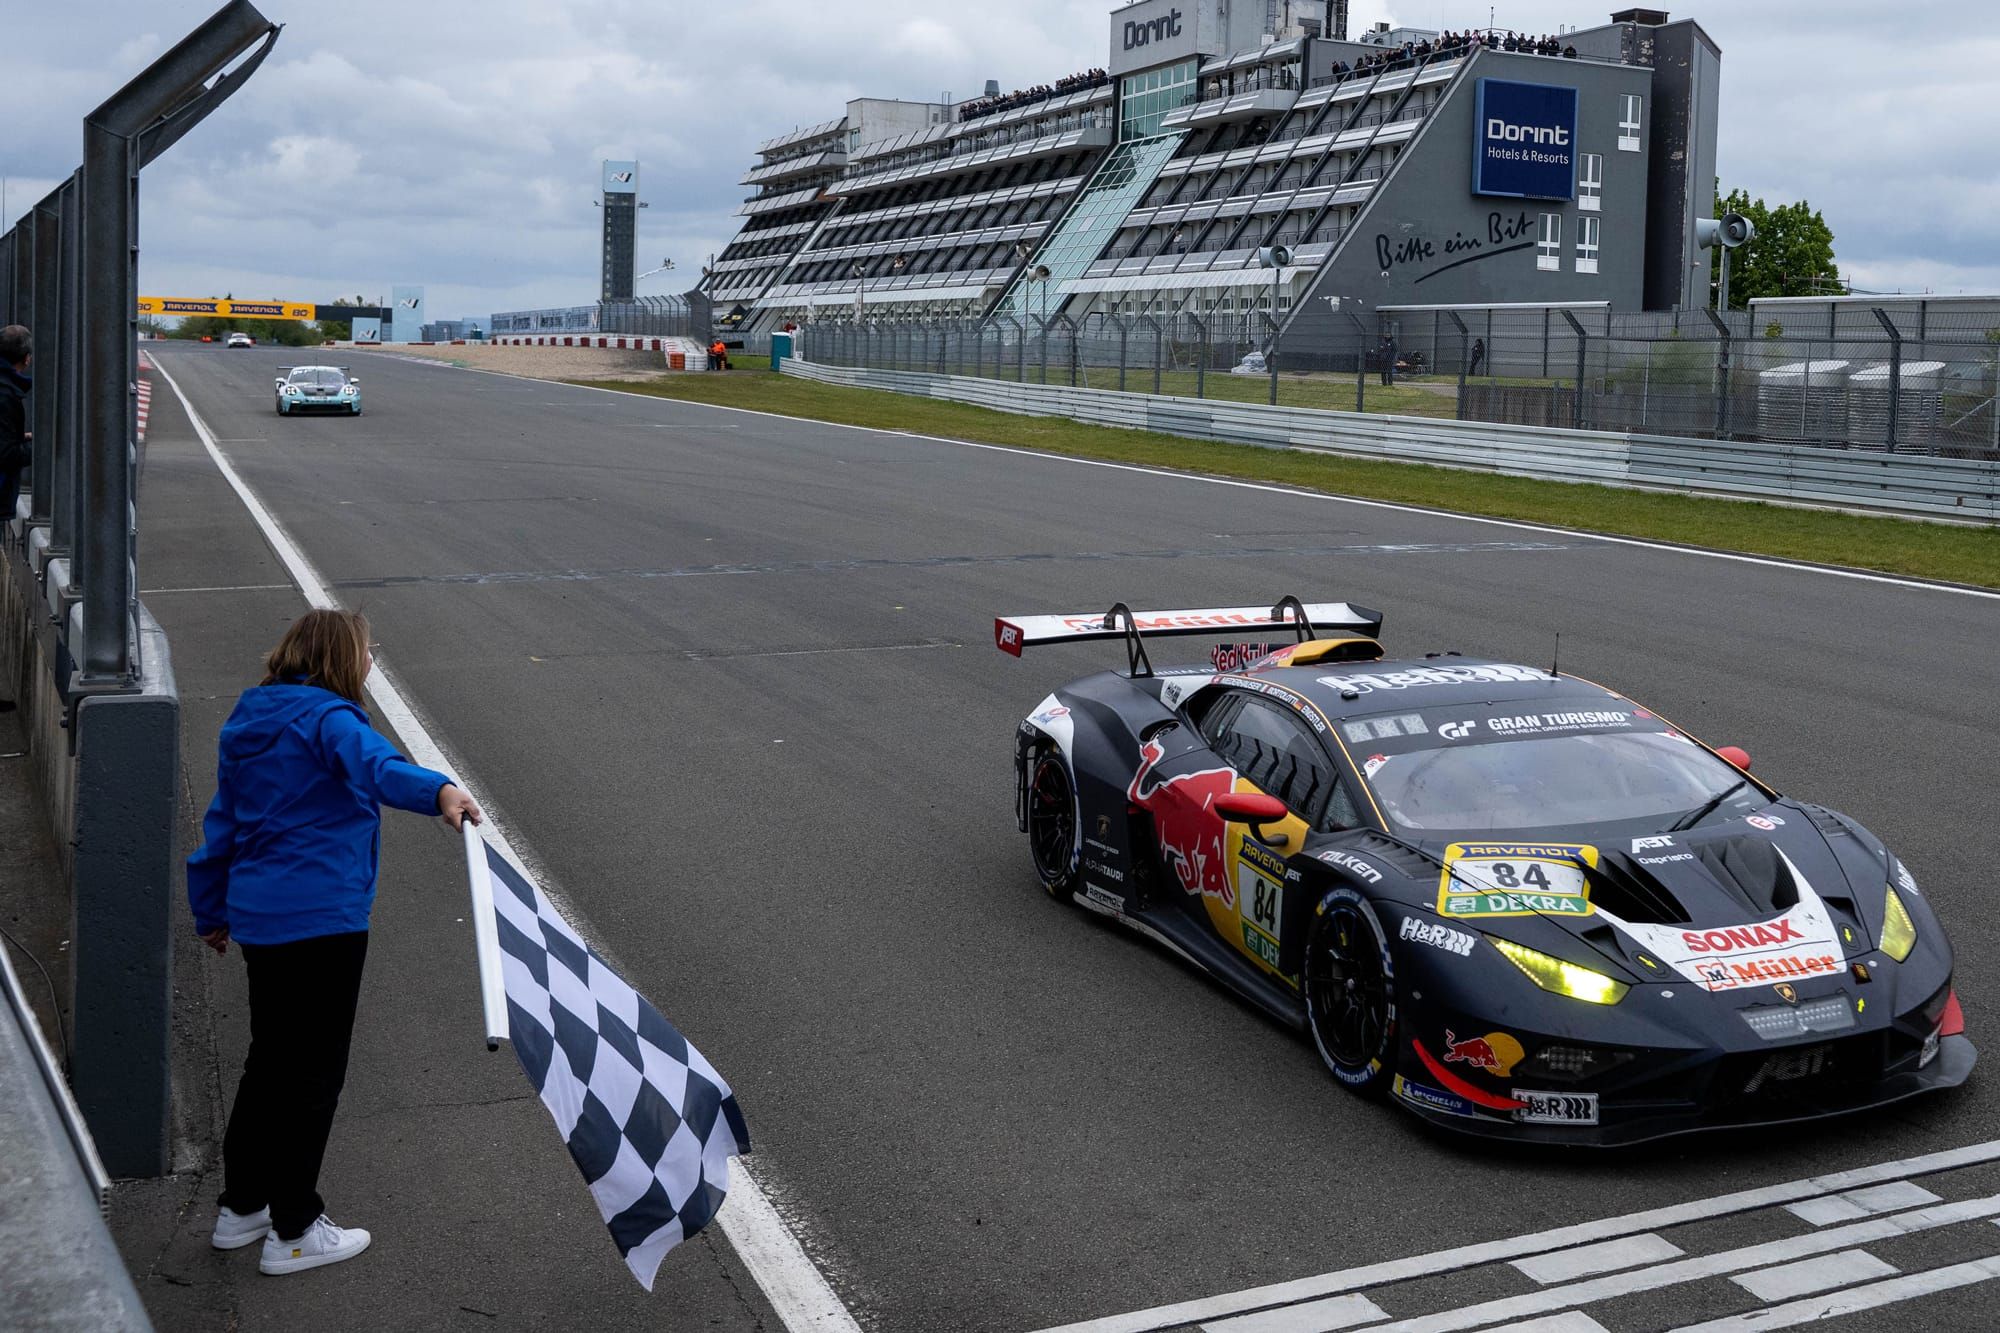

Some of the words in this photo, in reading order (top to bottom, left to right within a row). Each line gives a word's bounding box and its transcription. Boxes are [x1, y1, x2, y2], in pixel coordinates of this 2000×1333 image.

[1124, 8, 1182, 50] Dorint
[1487, 118, 1569, 146] Dorint
[1488, 146, 1520, 161] Hotels
[1521, 149, 1530, 161] &
[1531, 150, 1569, 165] Resorts
[1375, 233, 1436, 271] Bitte
[1445, 232, 1482, 254] ein
[1487, 211, 1535, 244] Bit
[166, 303, 214, 312] RAVENOL
[233, 305, 281, 314] RAVENOL
[1488, 715, 1542, 731] GRAN
[1542, 711, 1627, 727] TURISMO
[1517, 727, 1542, 736] REAL
[1543, 724, 1581, 733] DRIVING
[1581, 721, 1633, 730] SIMULATOR
[1470, 846, 1578, 858] RAVENOL
[1631, 835, 1677, 854] ABT
[1638, 852, 1694, 865] Capristo
[1245, 842, 1285, 878] RAVENO
[1317, 850, 1383, 884] FALKEN
[1491, 862, 1552, 891] 84
[1254, 878, 1277, 932] 84
[1487, 893, 1580, 913] DEKRA
[1400, 916, 1453, 949] H&R
[1682, 918, 1806, 954] SONAX
[1730, 953, 1838, 984] Müller
